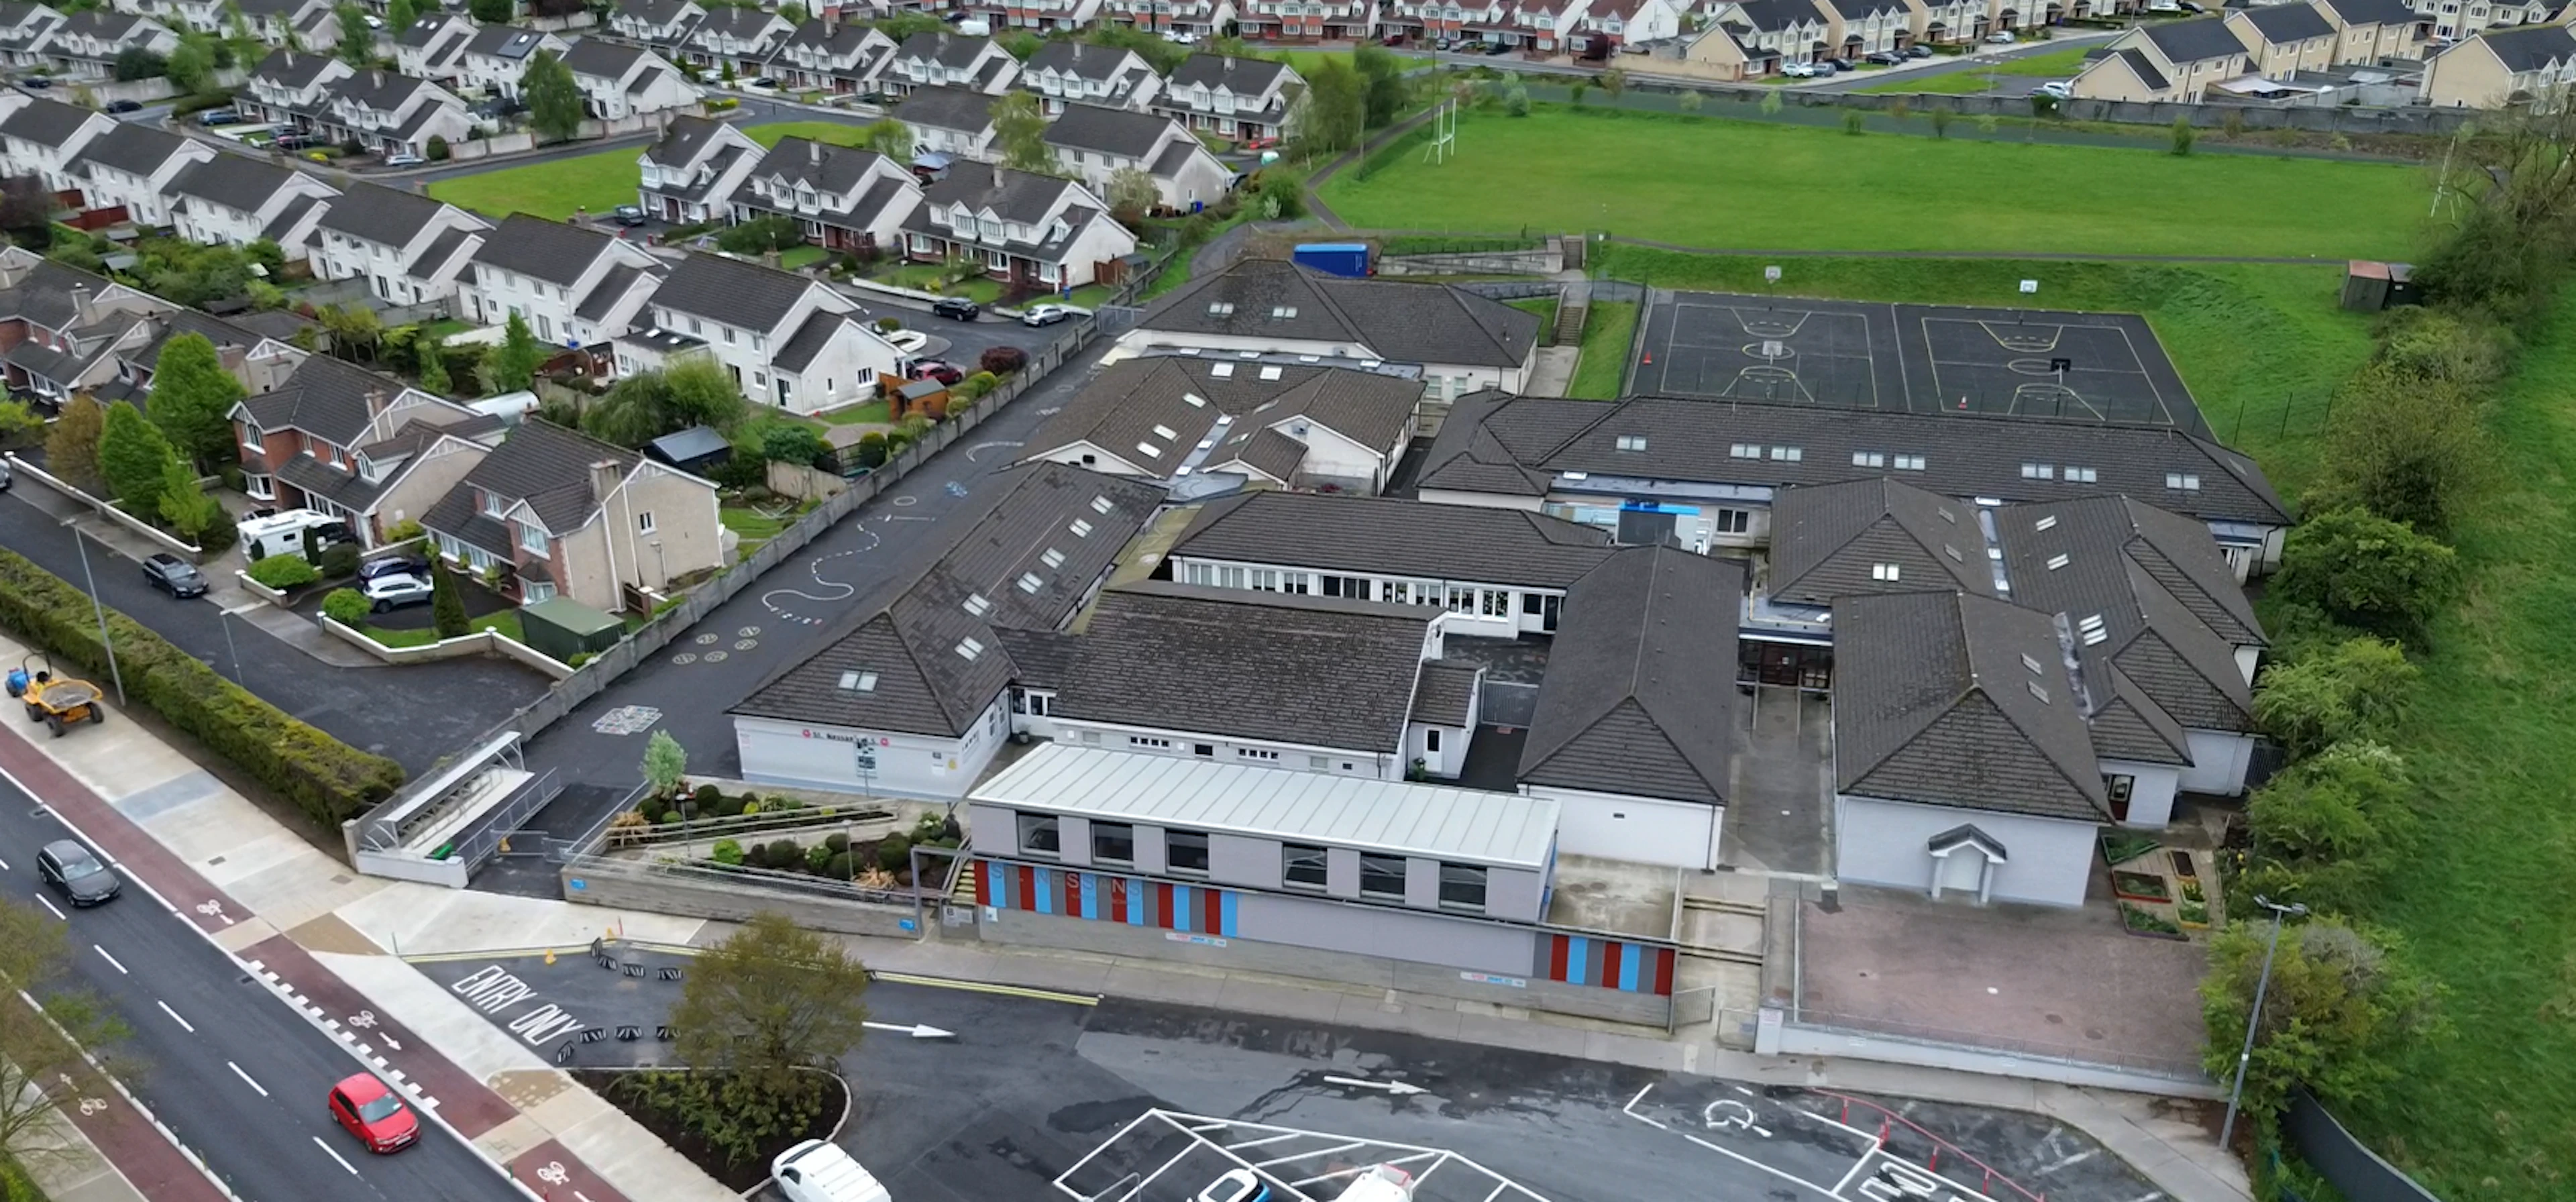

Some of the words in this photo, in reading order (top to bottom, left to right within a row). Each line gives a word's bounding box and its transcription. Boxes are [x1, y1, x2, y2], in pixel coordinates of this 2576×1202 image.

[1036, 868, 1141, 897] NESSANS
[451, 965, 537, 1014] ENTRY
[508, 1003, 585, 1046] ONLY
